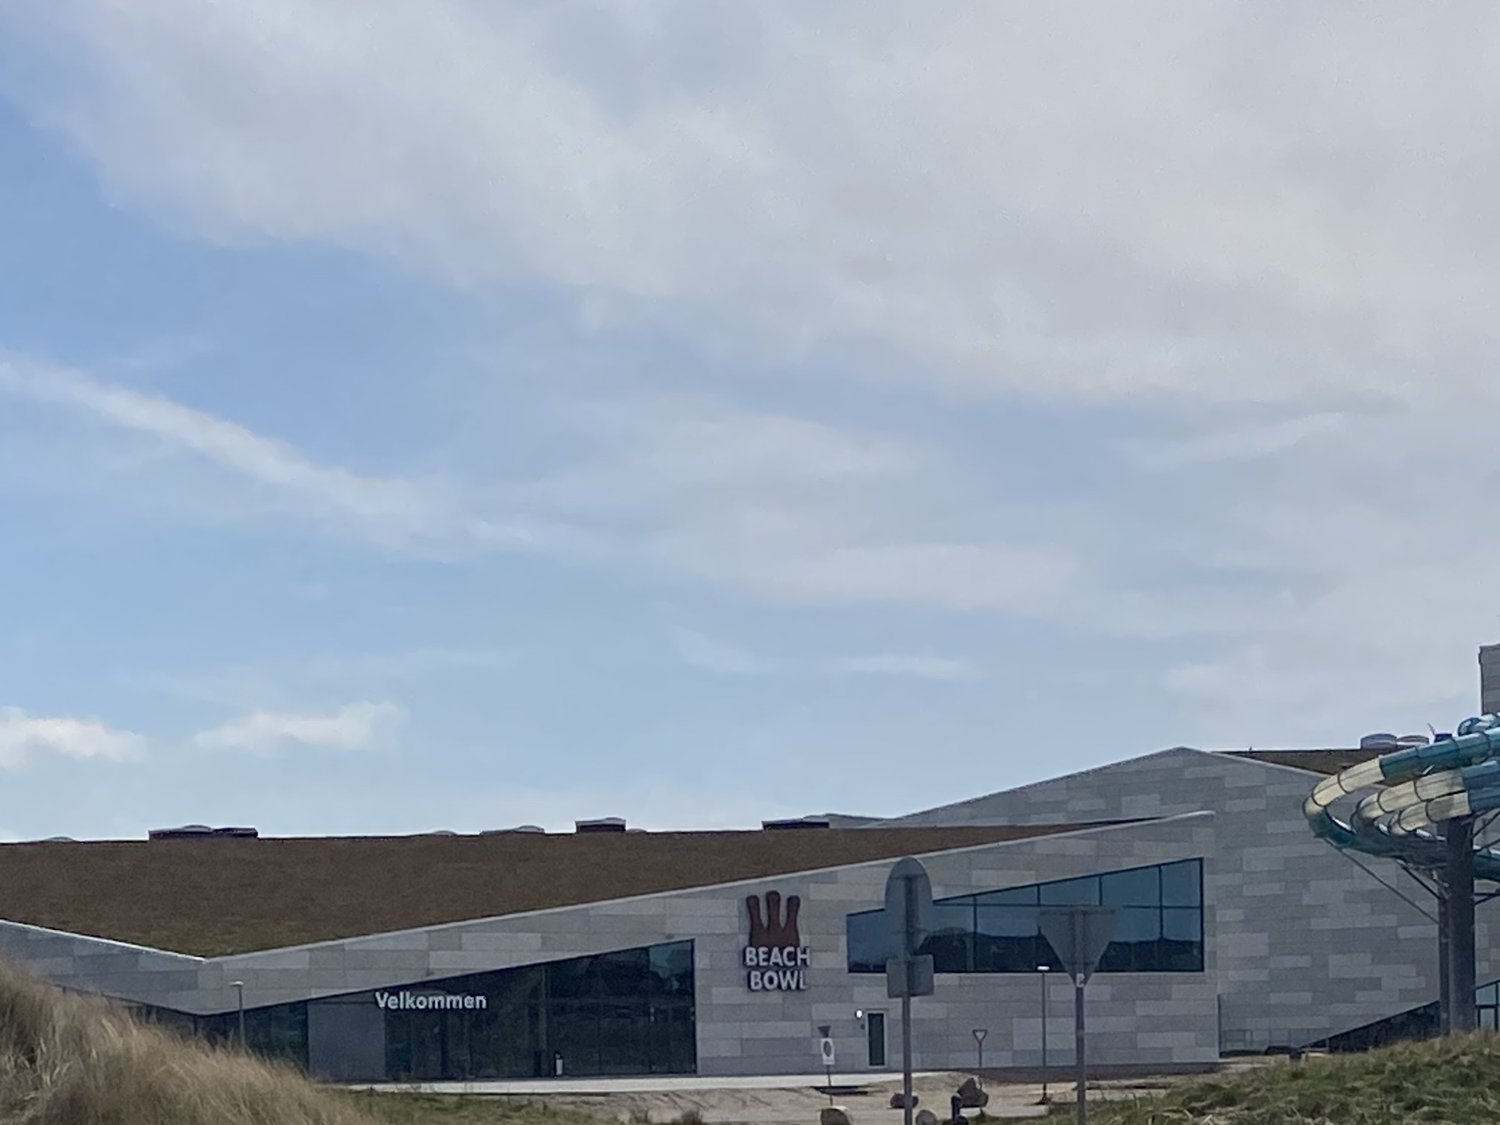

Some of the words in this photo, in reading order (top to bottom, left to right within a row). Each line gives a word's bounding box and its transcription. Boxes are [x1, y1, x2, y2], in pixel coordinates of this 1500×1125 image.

[745, 946, 810, 966] BEACH
[750, 970, 806, 990] BOWL
[375, 991, 487, 1009] Velkommen
